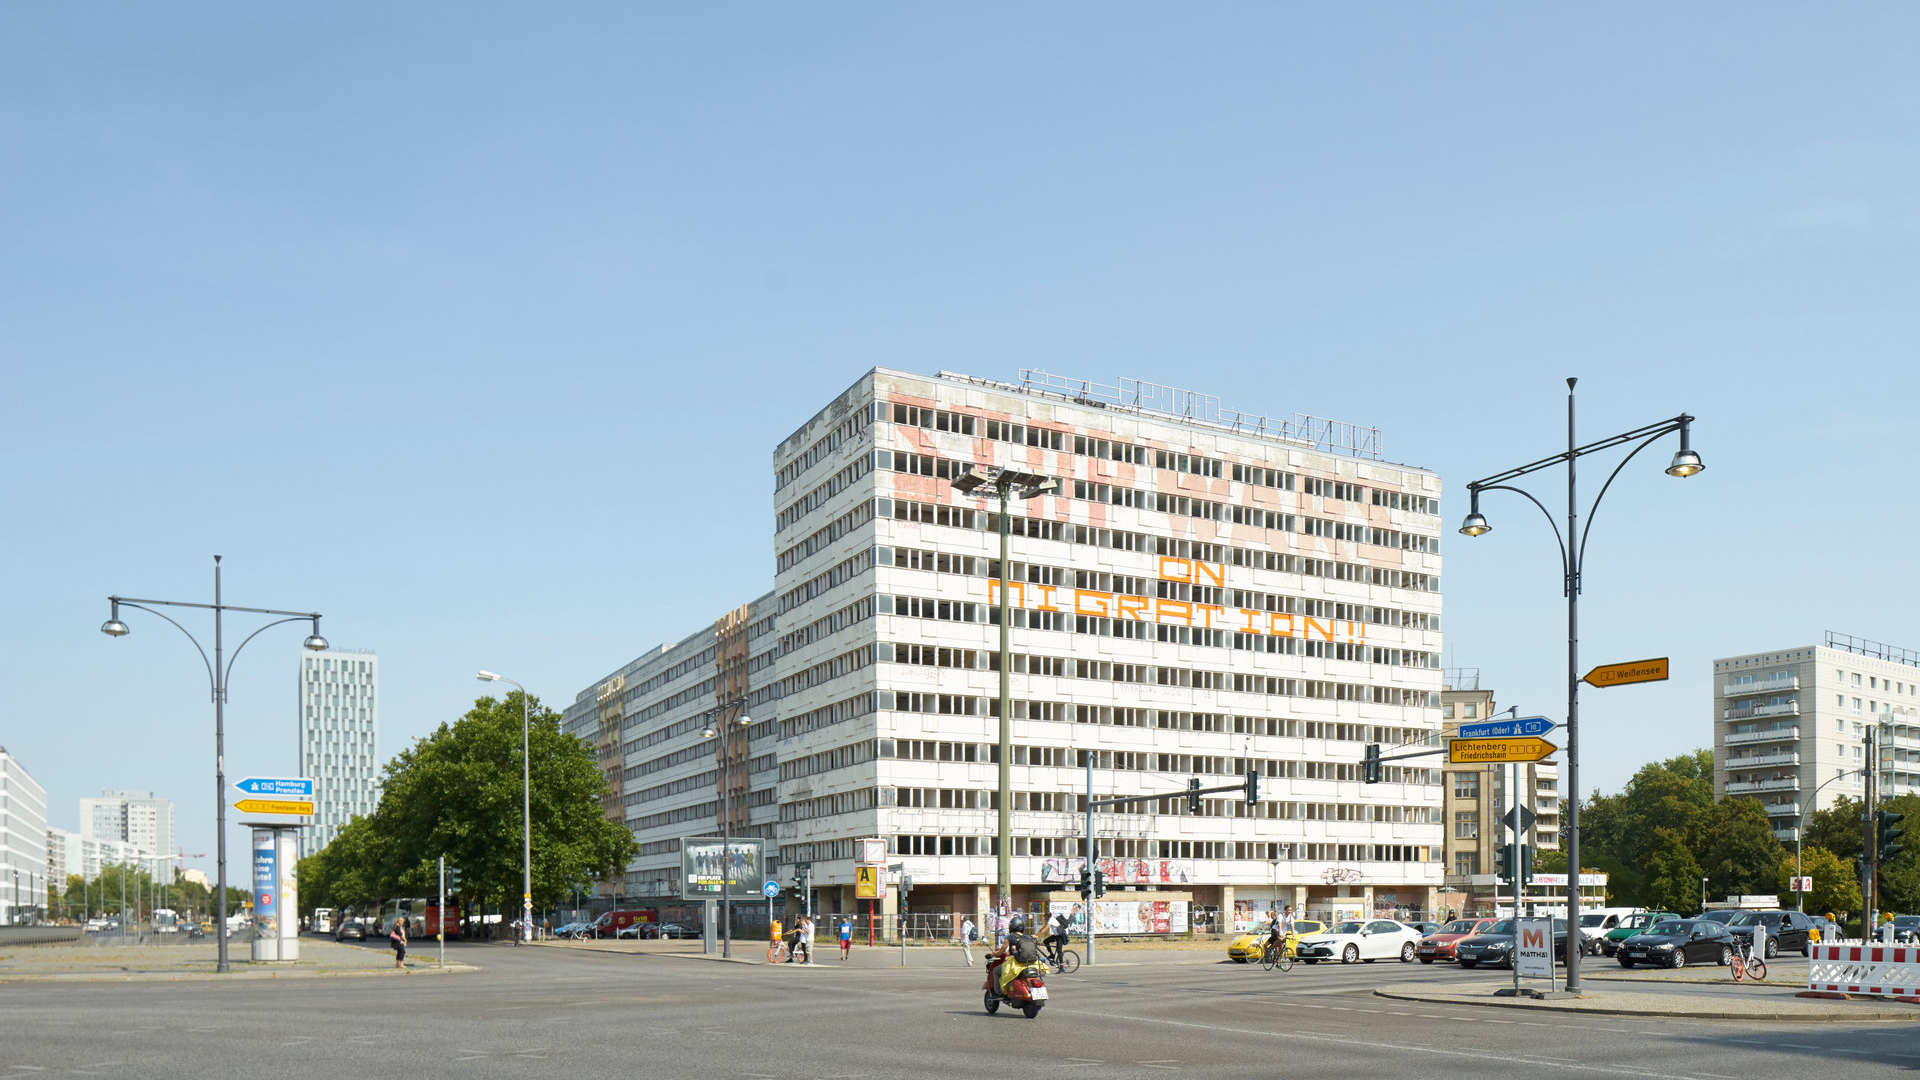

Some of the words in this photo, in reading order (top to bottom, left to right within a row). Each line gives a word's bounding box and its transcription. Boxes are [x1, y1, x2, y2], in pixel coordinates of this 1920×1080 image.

[1159, 556, 1225, 588] ON
[1616, 667, 1661, 678] Weißensee
[1462, 728, 1490, 738] Frankfurt
[1492, 726, 1510, 735] (Oder)
[1455, 743, 1507, 751] Lichtenberg
[275, 780, 306, 789] Hamburg
[299, 805, 310, 813] Berg
[860, 867, 870, 882] A
[1523, 928, 1544, 949] M
